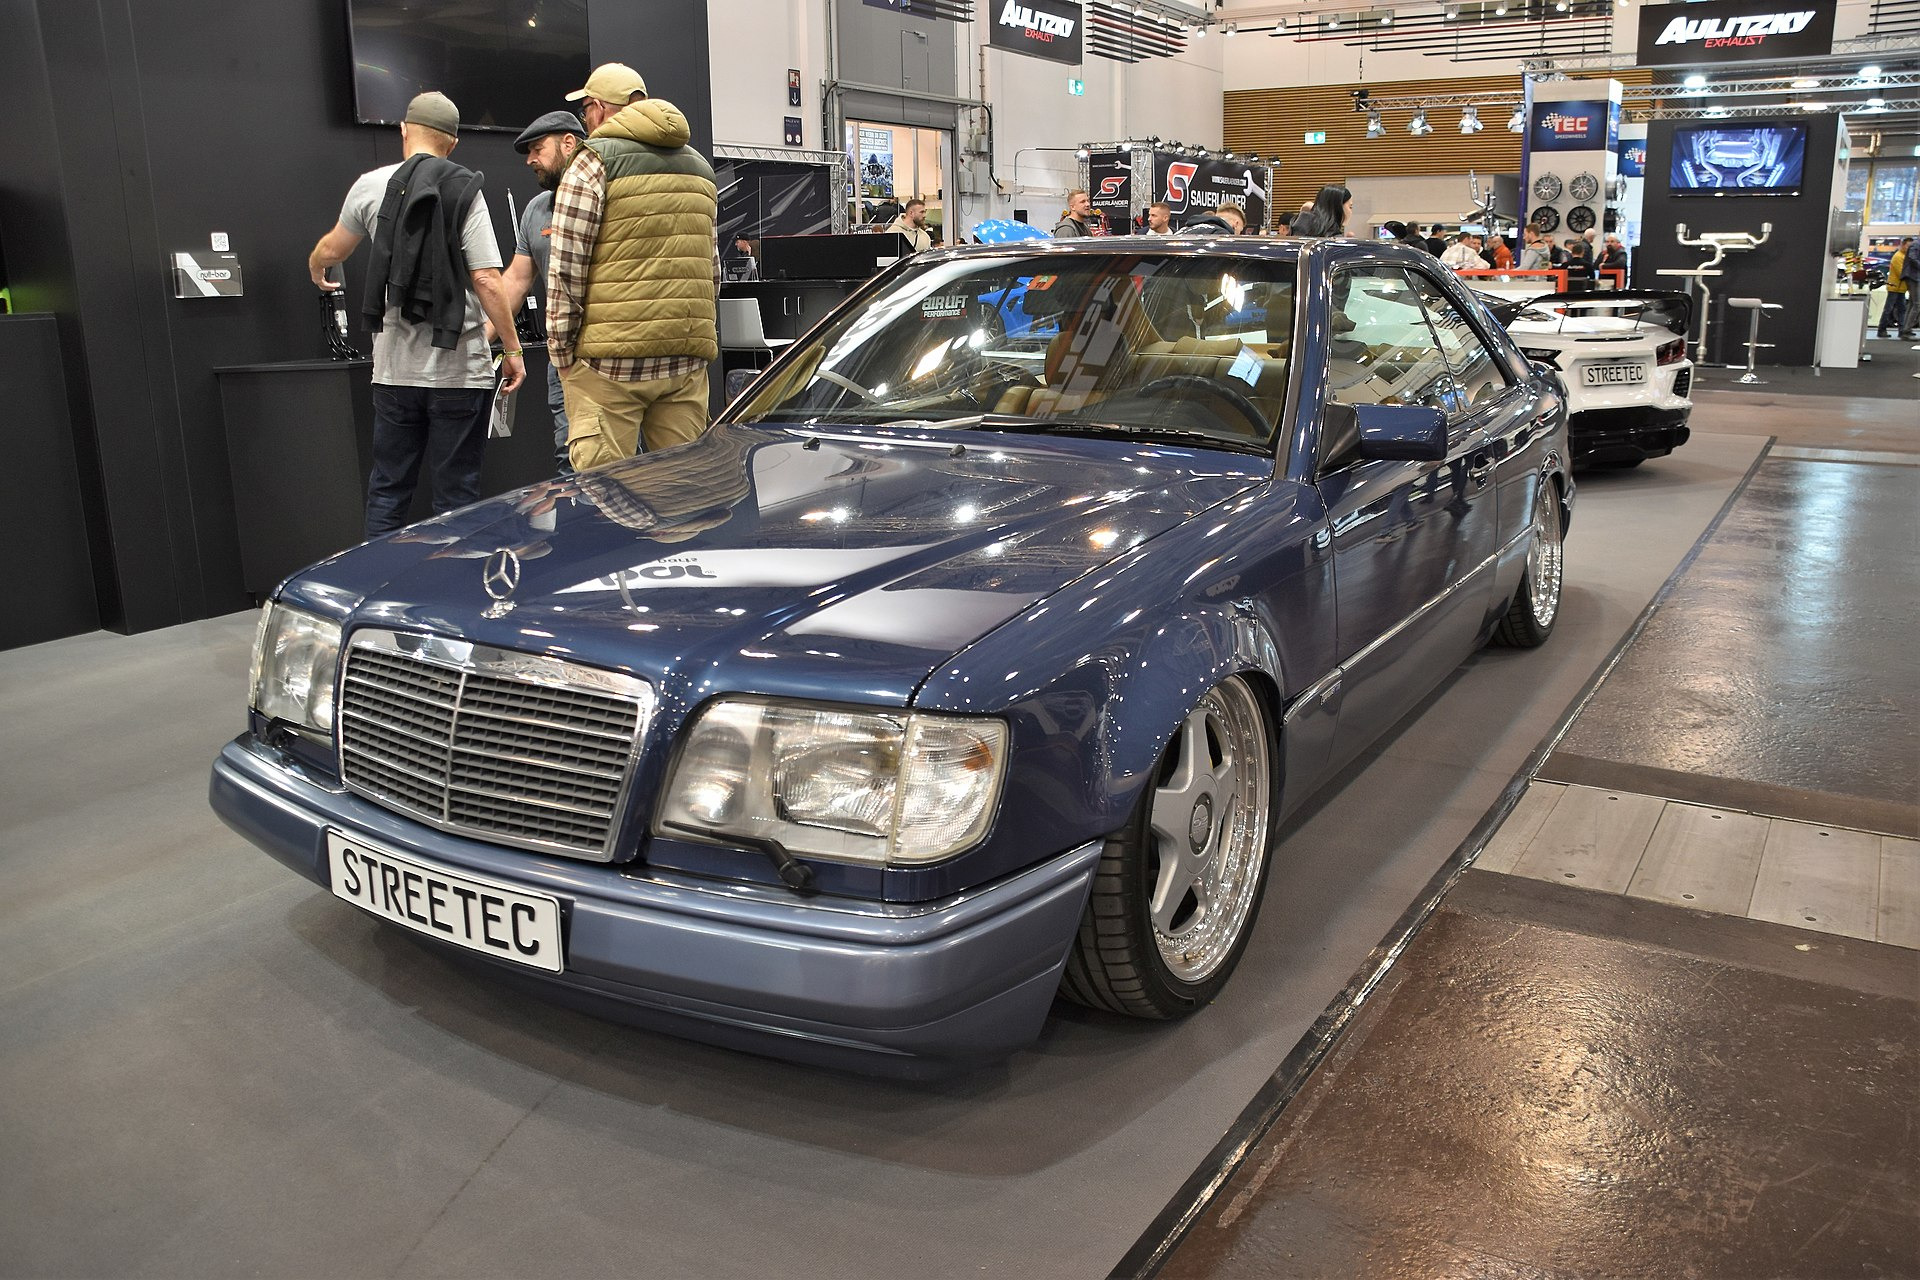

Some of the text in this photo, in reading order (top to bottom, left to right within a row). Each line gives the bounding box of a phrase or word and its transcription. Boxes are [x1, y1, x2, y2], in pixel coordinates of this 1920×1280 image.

[999, 0, 1076, 38] AULITZKY
[1025, 28, 1054, 43] EXHAUST
[1655, 10, 1816, 45] AULITZKY
[1705, 35, 1766, 48] EXHAUST
[1553, 117, 1588, 132] TEC
[945, 295, 968, 309] LIFT
[1587, 366, 1643, 383] STREETEC
[342, 848, 540, 956] STREETEC
